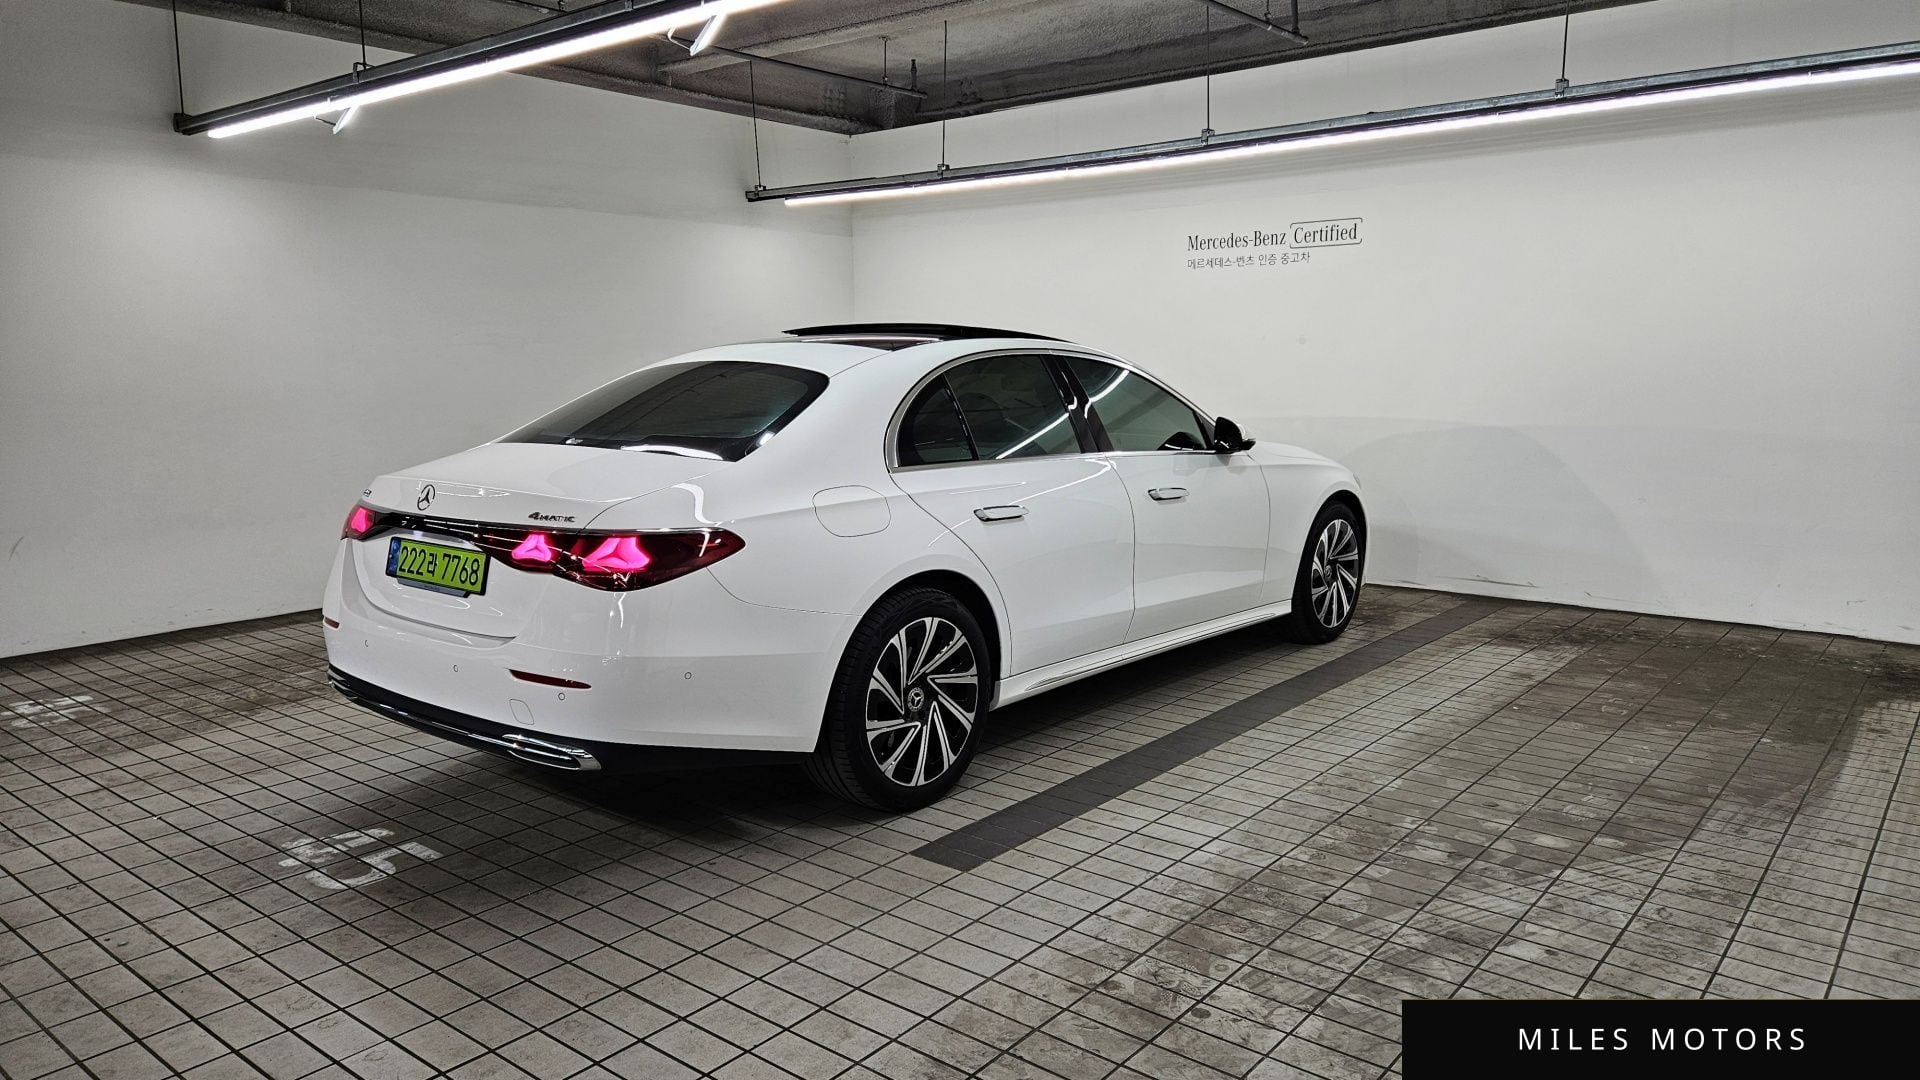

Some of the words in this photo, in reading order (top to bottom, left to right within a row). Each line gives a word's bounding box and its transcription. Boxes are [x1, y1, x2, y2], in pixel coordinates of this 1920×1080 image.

[1187, 230, 1287, 251] Mercedes-Benz
[1294, 223, 1358, 244] Certified
[1187, 254, 1255, 269] 메르세데스-벤츠
[1258, 253, 1277, 266] 인증
[1280, 251, 1311, 264] 중고차
[528, 511, 575, 523] 4MATIC
[398, 546, 438, 577] 222라
[441, 552, 480, 586] 7768
